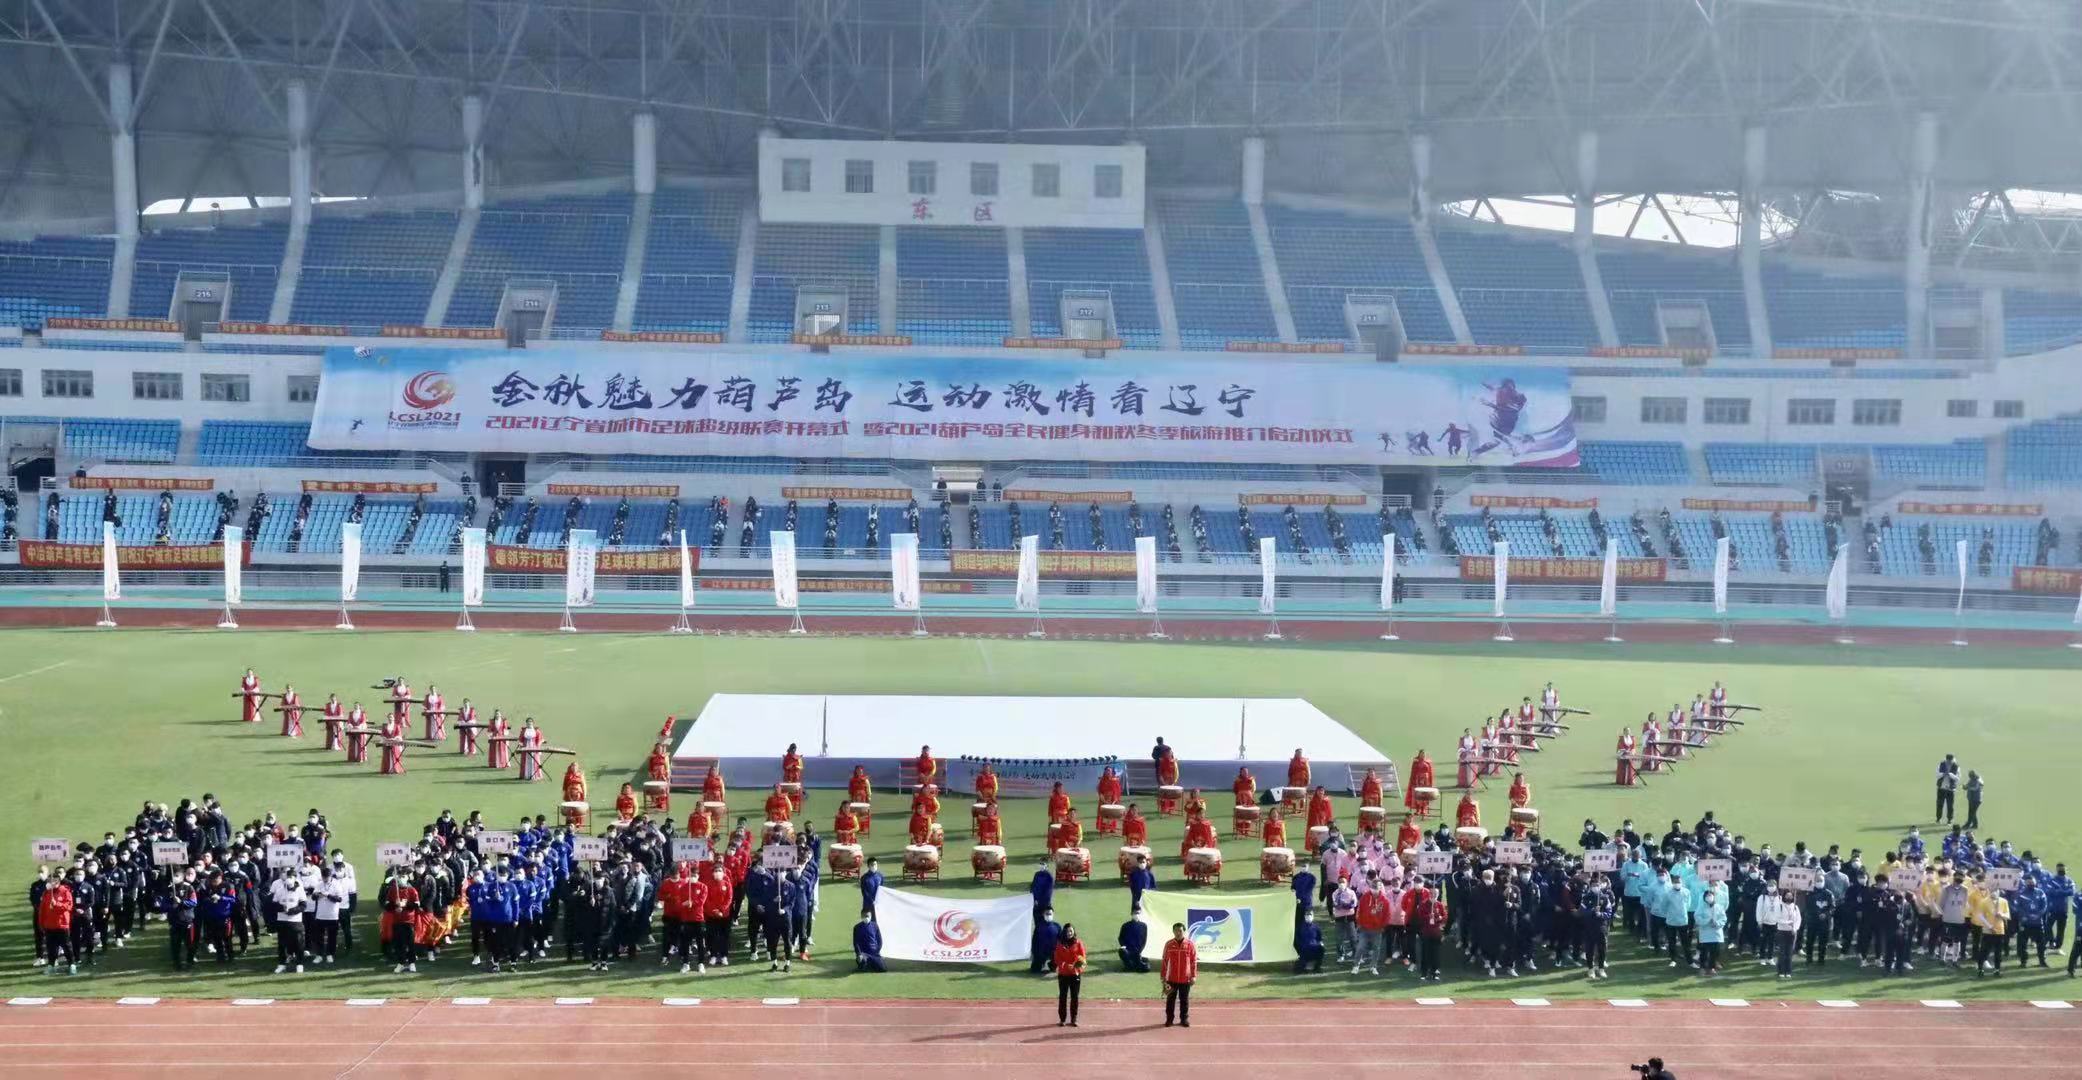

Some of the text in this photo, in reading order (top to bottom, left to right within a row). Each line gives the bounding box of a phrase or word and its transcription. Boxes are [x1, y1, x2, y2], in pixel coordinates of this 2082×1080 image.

[492, 369, 1256, 418] 金秋魅力葫芦岛 运动激情看辽宁
[389, 411, 461, 422] LCSL2021
[923, 949, 988, 957] LCSL2021
